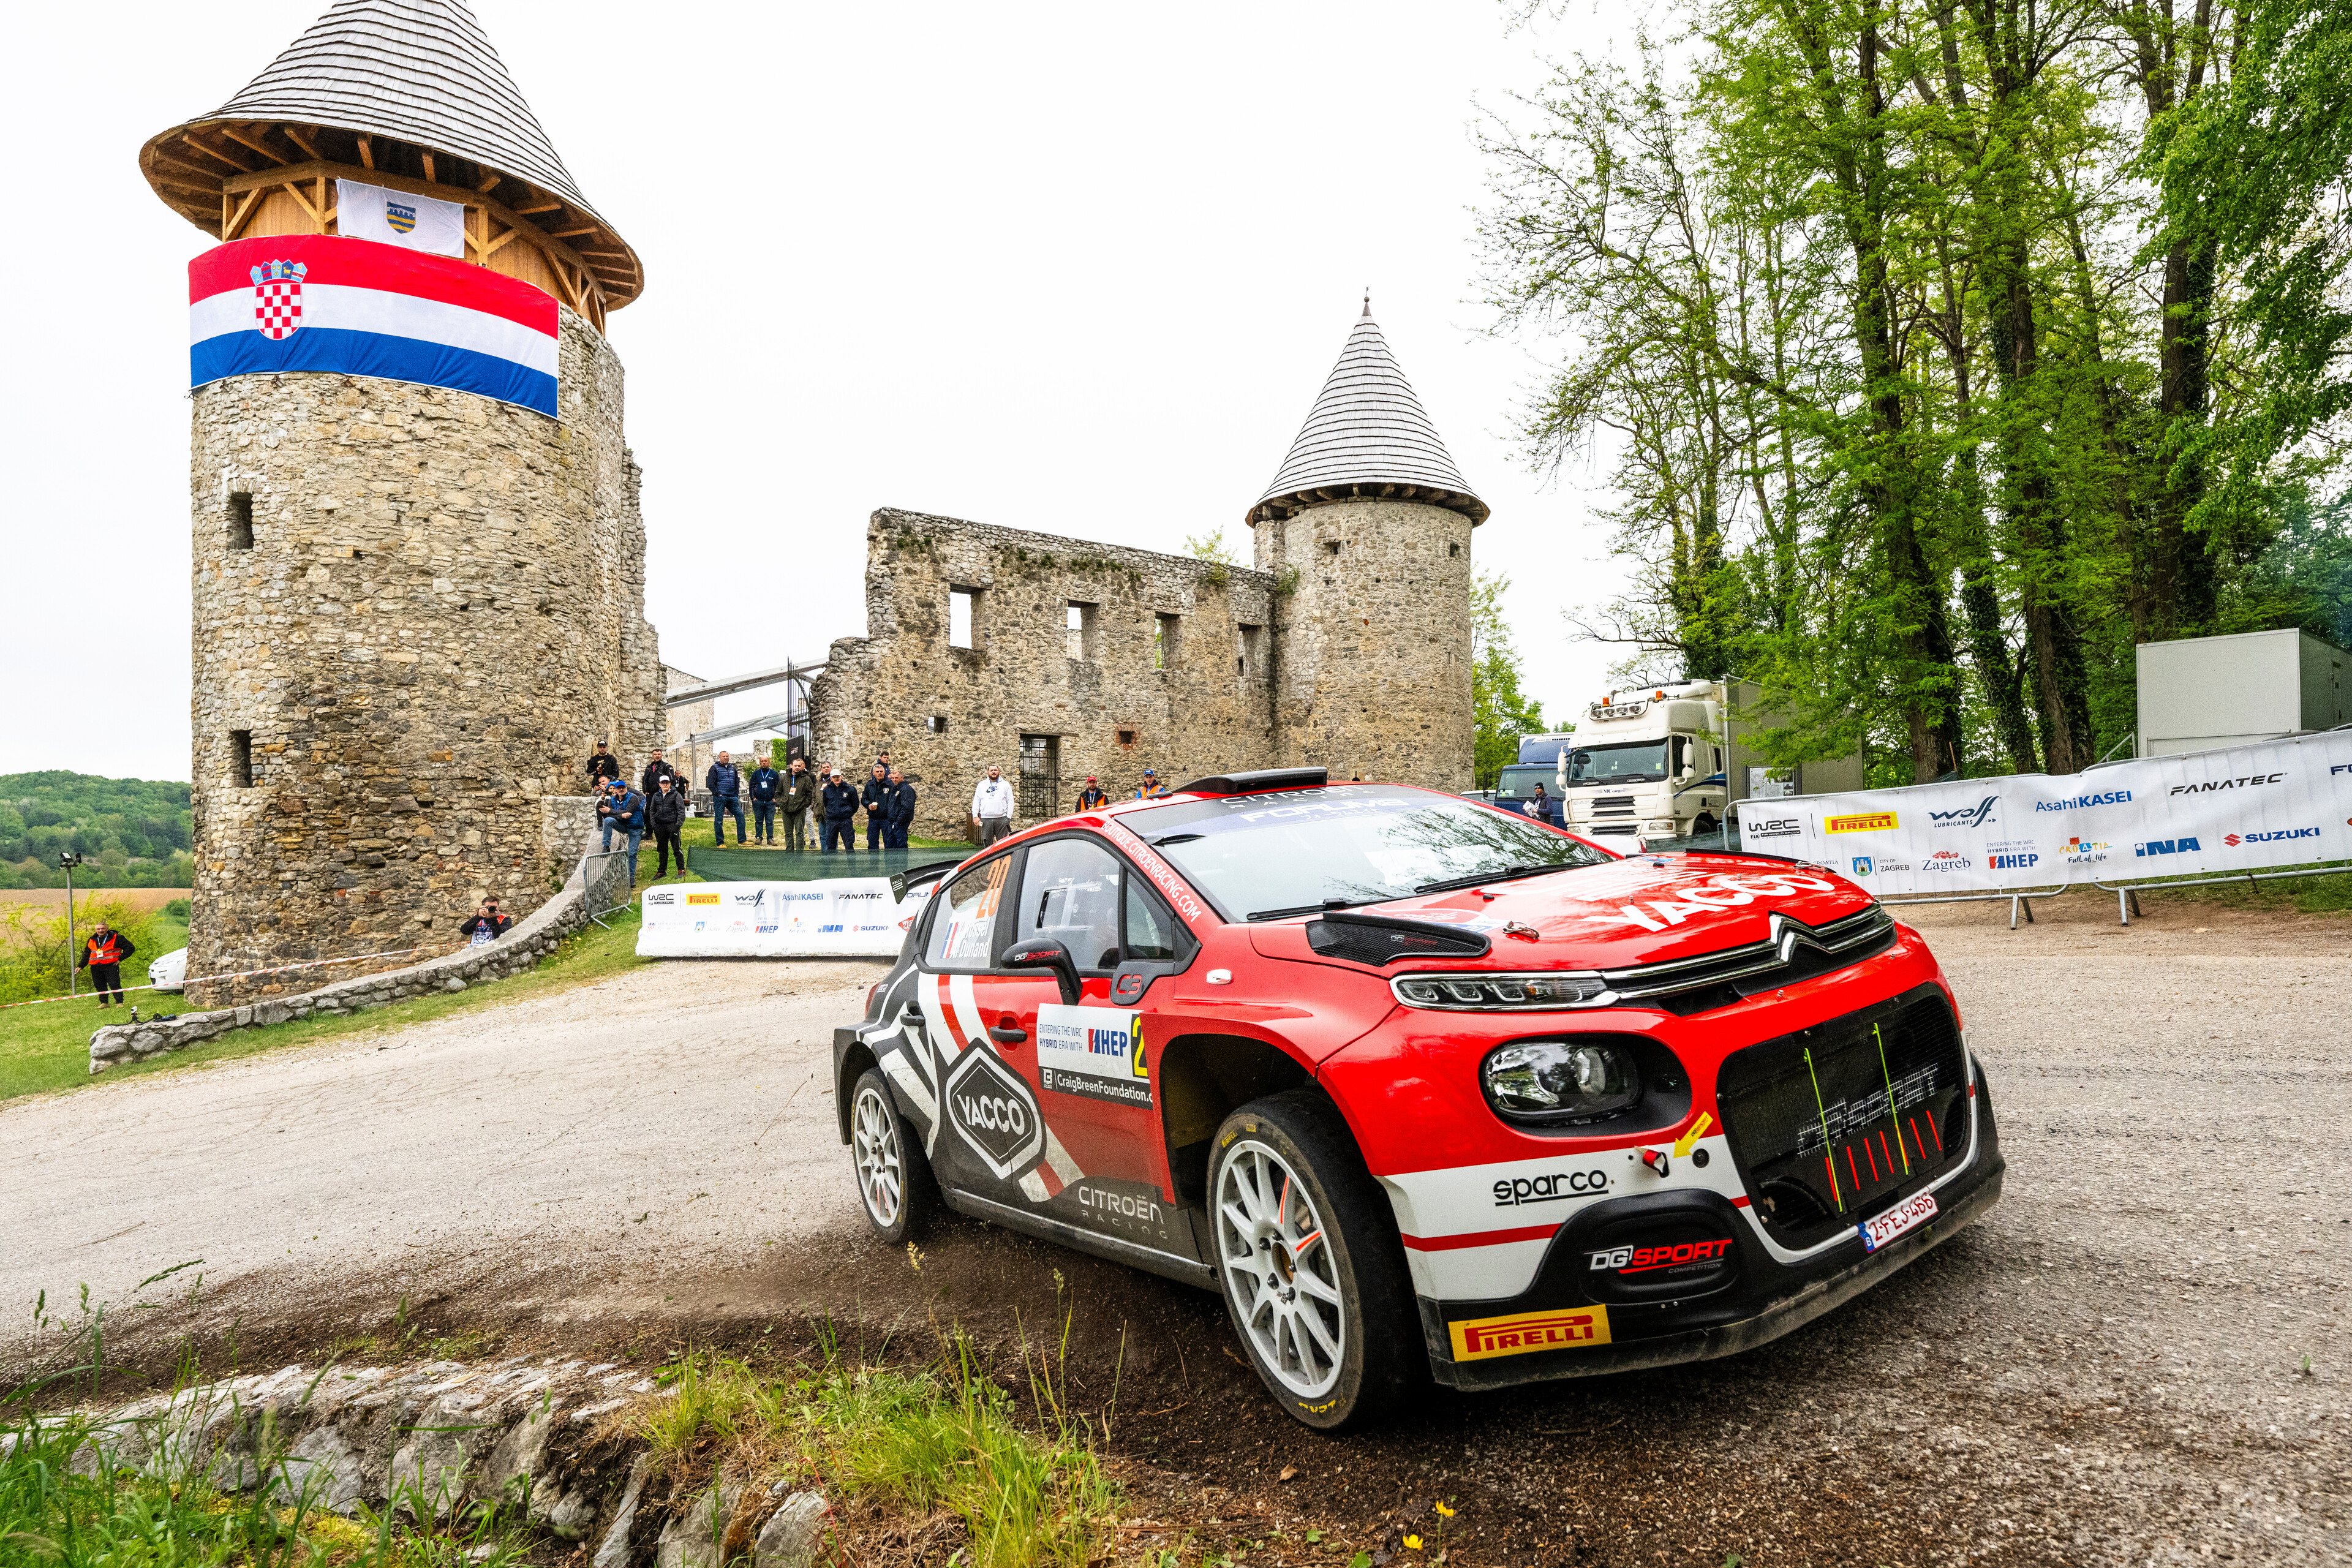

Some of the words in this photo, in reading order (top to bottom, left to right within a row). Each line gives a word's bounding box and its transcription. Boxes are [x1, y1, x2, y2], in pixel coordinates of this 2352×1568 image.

[2170, 773, 2283, 796] FANATEC
[1927, 796, 1999, 827] wolf
[2035, 791, 2132, 812] AsahiKASEI
[1748, 819, 1800, 832] WRC
[1831, 815, 1891, 831] PIRELLI
[2245, 827, 2320, 843] SUZUKI
[2135, 837, 2201, 857] INA
[1880, 864, 1910, 872] ZAGREB
[1922, 858, 1970, 872] Zagreb
[2006, 853, 2038, 868] HEP
[976, 855, 1011, 919] 20
[735, 889, 766, 907] wolf
[1578, 872, 1835, 932] YACCO
[1117, 974, 1142, 995] C3
[1039, 1024, 1061, 1036] ENTERING
[1061, 1026, 1070, 1036] THE
[1071, 1027, 1082, 1037] WRC
[1039, 1038, 1058, 1049] HYBRID
[1058, 1040, 1068, 1050] ERA
[1069, 1042, 1082, 1052] WITH
[1101, 1029, 1128, 1057] HEP
[957, 1094, 1026, 1136] YACCO
[1493, 1169, 1608, 1207] sparco
[1865, 1237, 1872, 1246] B
[1589, 1250, 1632, 1270] DG
[1632, 1239, 1733, 1267] SPORT
[1668, 1262, 1722, 1274] COMPETITION
[1464, 1315, 1593, 1353] PIRELLI
